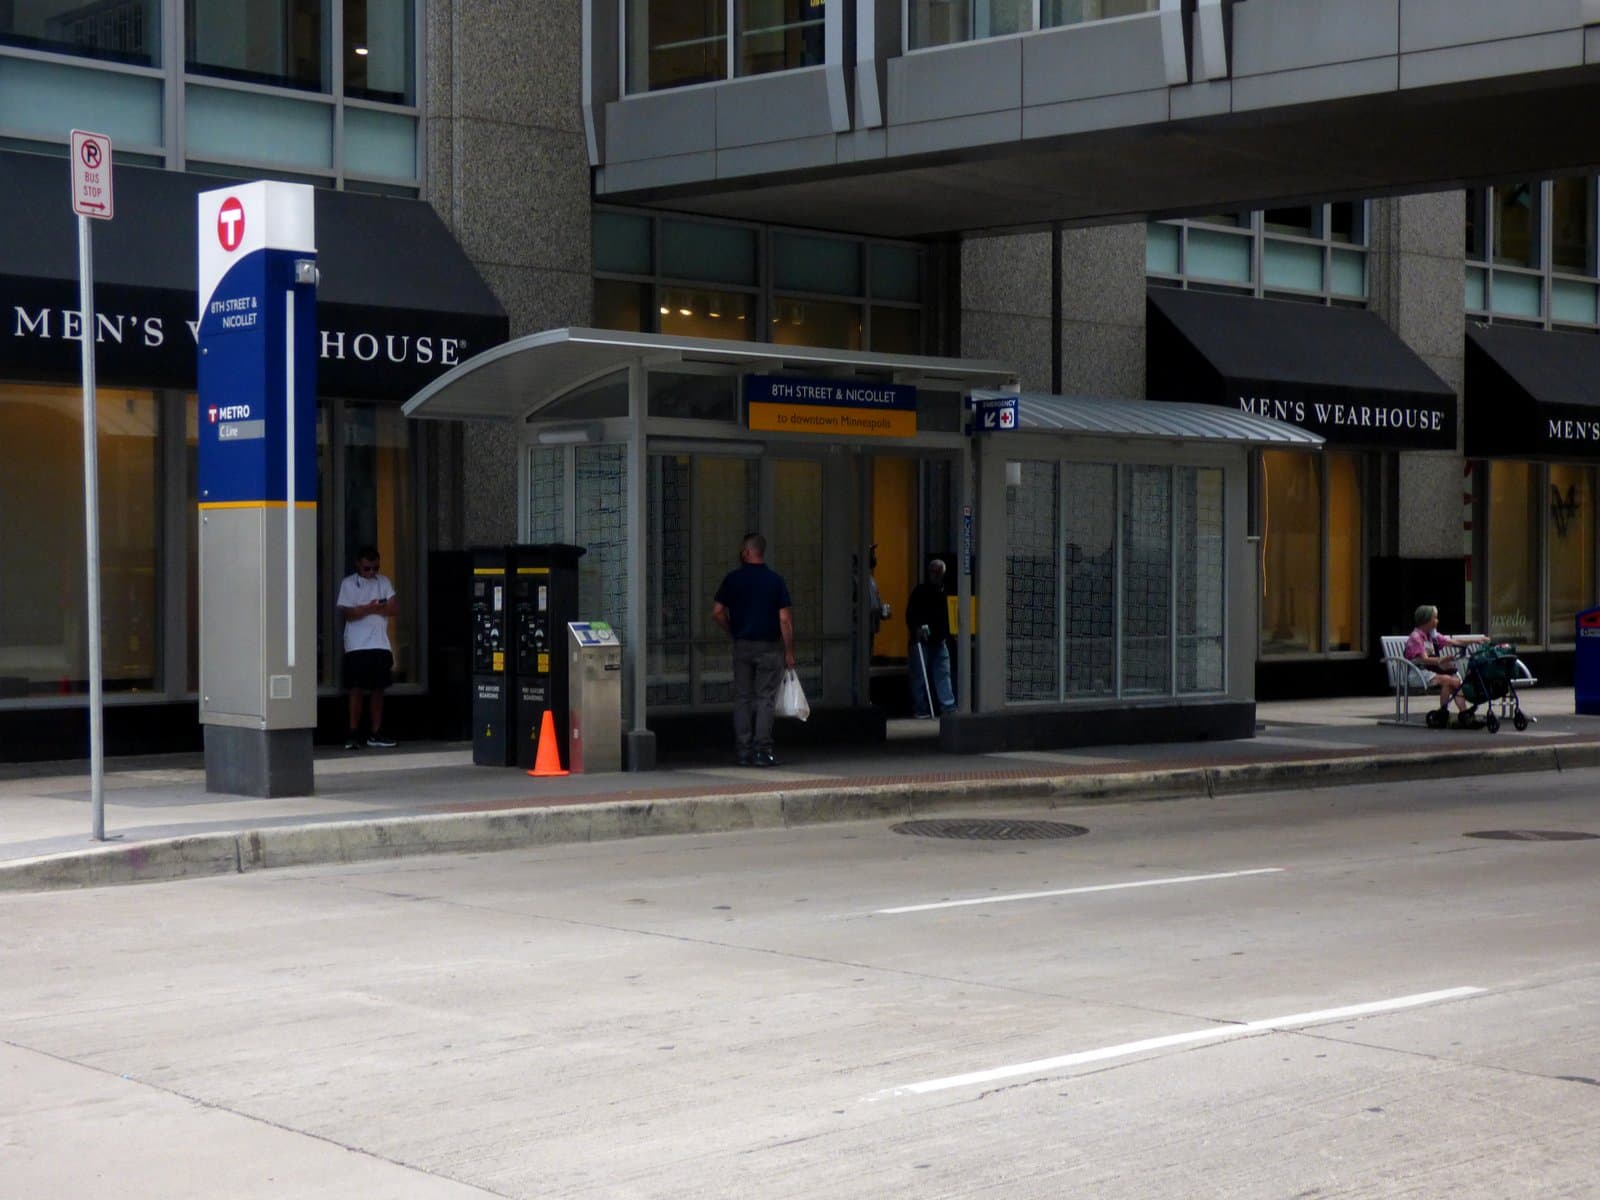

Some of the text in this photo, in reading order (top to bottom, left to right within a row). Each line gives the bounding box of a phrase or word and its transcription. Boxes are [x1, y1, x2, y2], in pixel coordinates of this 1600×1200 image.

[84, 172, 100, 184] BUS
[83, 186, 102, 198] STOP
[220, 208, 242, 246] T
[210, 296, 258, 314] 8TH STREET &
[14, 306, 165, 347] MEN'S
[222, 313, 258, 329] NICOLLET
[771, 384, 896, 404] 8TH STREET & NICOLLET
[219, 404, 250, 420] METRO
[1239, 397, 1442, 431] MEN'S WEARHOUSE
[777, 413, 892, 431] to downtown Minneapolis
[1548, 419, 1600, 441] MEN'S
[219, 425, 239, 438] C Line
